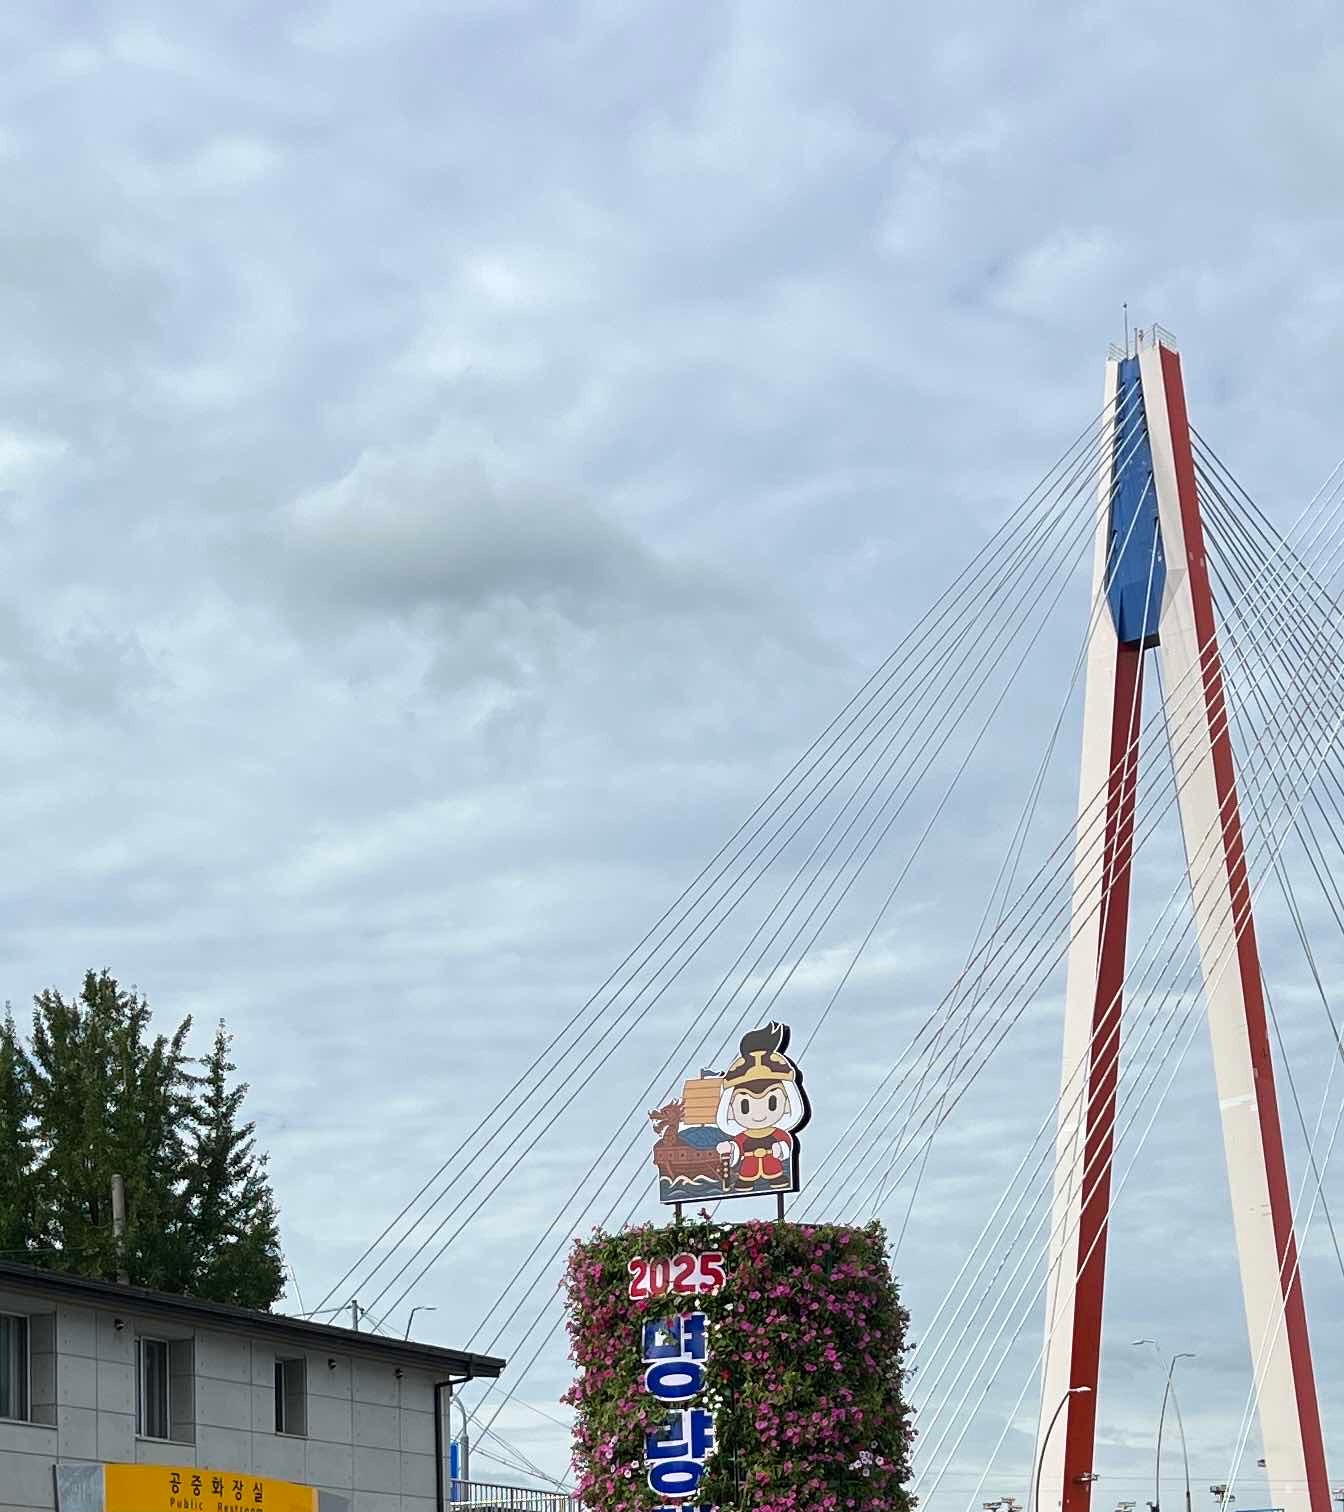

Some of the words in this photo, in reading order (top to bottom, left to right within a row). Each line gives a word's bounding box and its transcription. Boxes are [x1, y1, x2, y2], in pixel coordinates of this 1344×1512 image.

[628, 1252, 726, 1300] 2025
[169, 1472, 263, 1503] 공중화장실
[169, 1497, 204, 1511] Public
